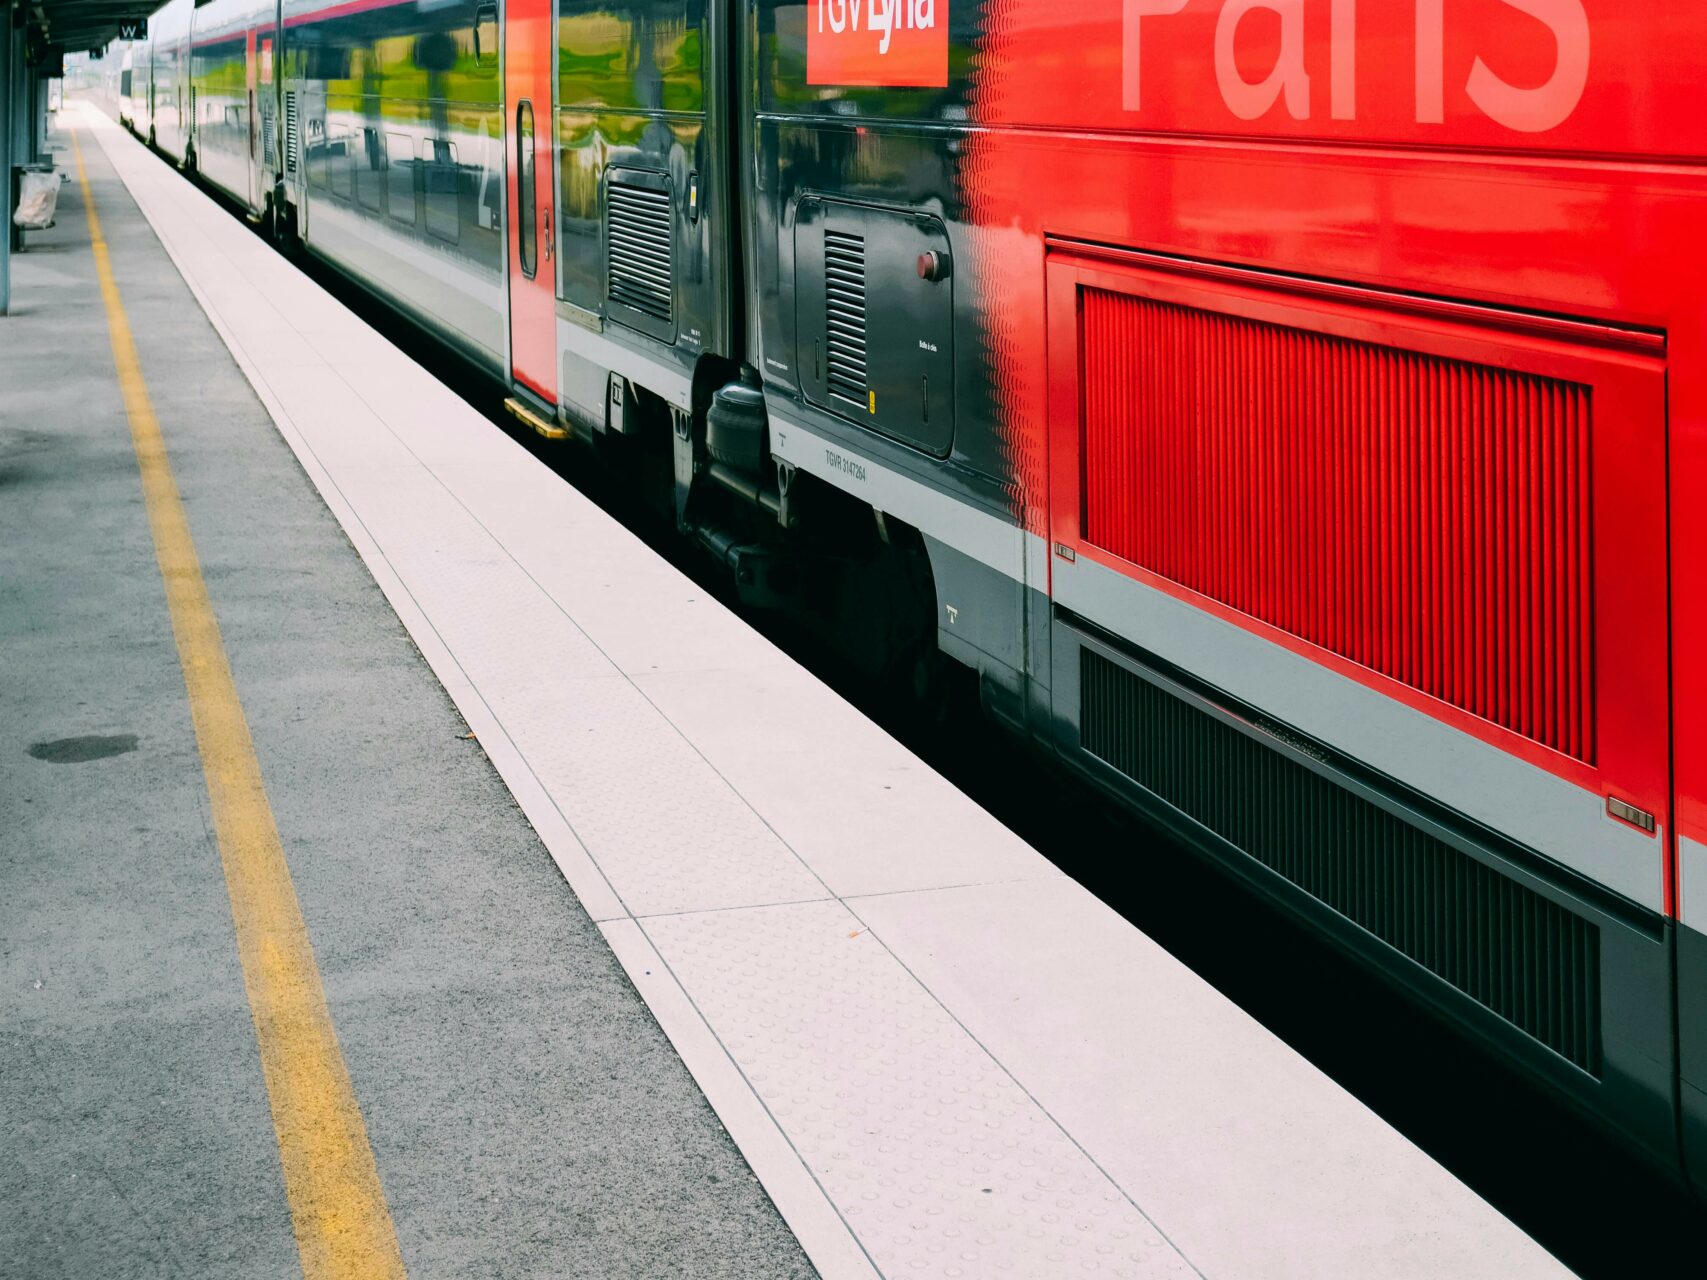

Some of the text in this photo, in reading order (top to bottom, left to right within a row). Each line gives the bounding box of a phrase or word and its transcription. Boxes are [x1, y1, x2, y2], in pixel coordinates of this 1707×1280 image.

[121, 25, 137, 38] W
[478, 112, 492, 230] 2
[825, 449, 842, 470] TGVR
